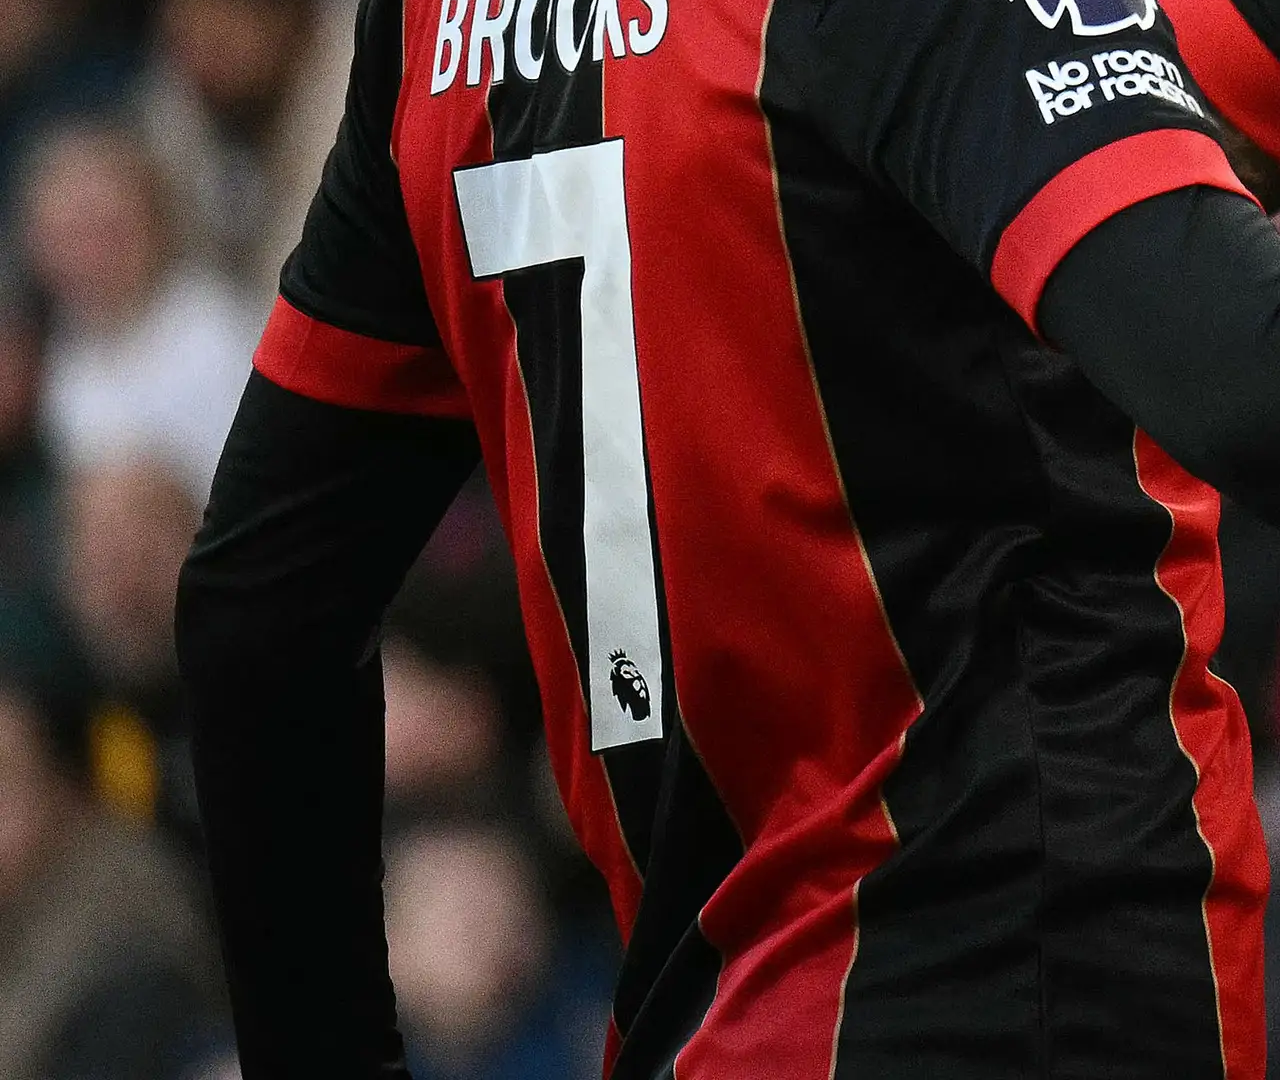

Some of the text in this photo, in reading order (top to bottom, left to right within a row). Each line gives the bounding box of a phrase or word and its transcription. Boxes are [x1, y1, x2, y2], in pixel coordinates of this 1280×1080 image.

[1025, 49, 1184, 103] No room
[1037, 83, 1095, 125] for
[453, 137, 663, 753] 7
